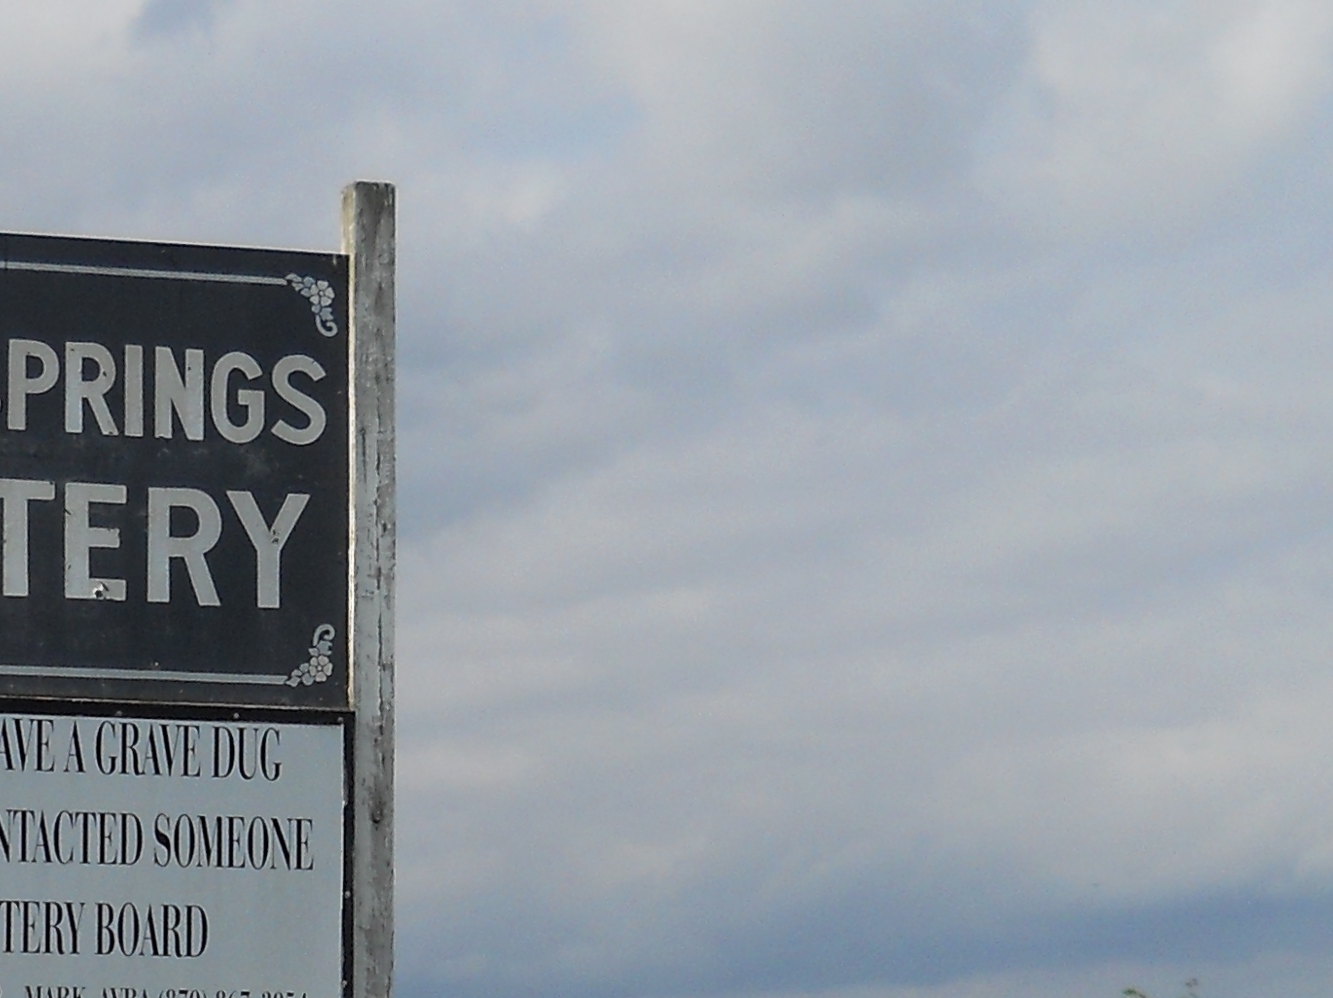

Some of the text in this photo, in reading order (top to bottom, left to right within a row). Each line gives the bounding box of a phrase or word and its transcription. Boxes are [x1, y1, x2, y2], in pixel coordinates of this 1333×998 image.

[63, 720, 86, 774] A
[95, 720, 201, 778] GRAVE
[211, 725, 282, 782] DUG
[153, 812, 315, 871] SOMEONE
[94, 902, 209, 958] BOARD
